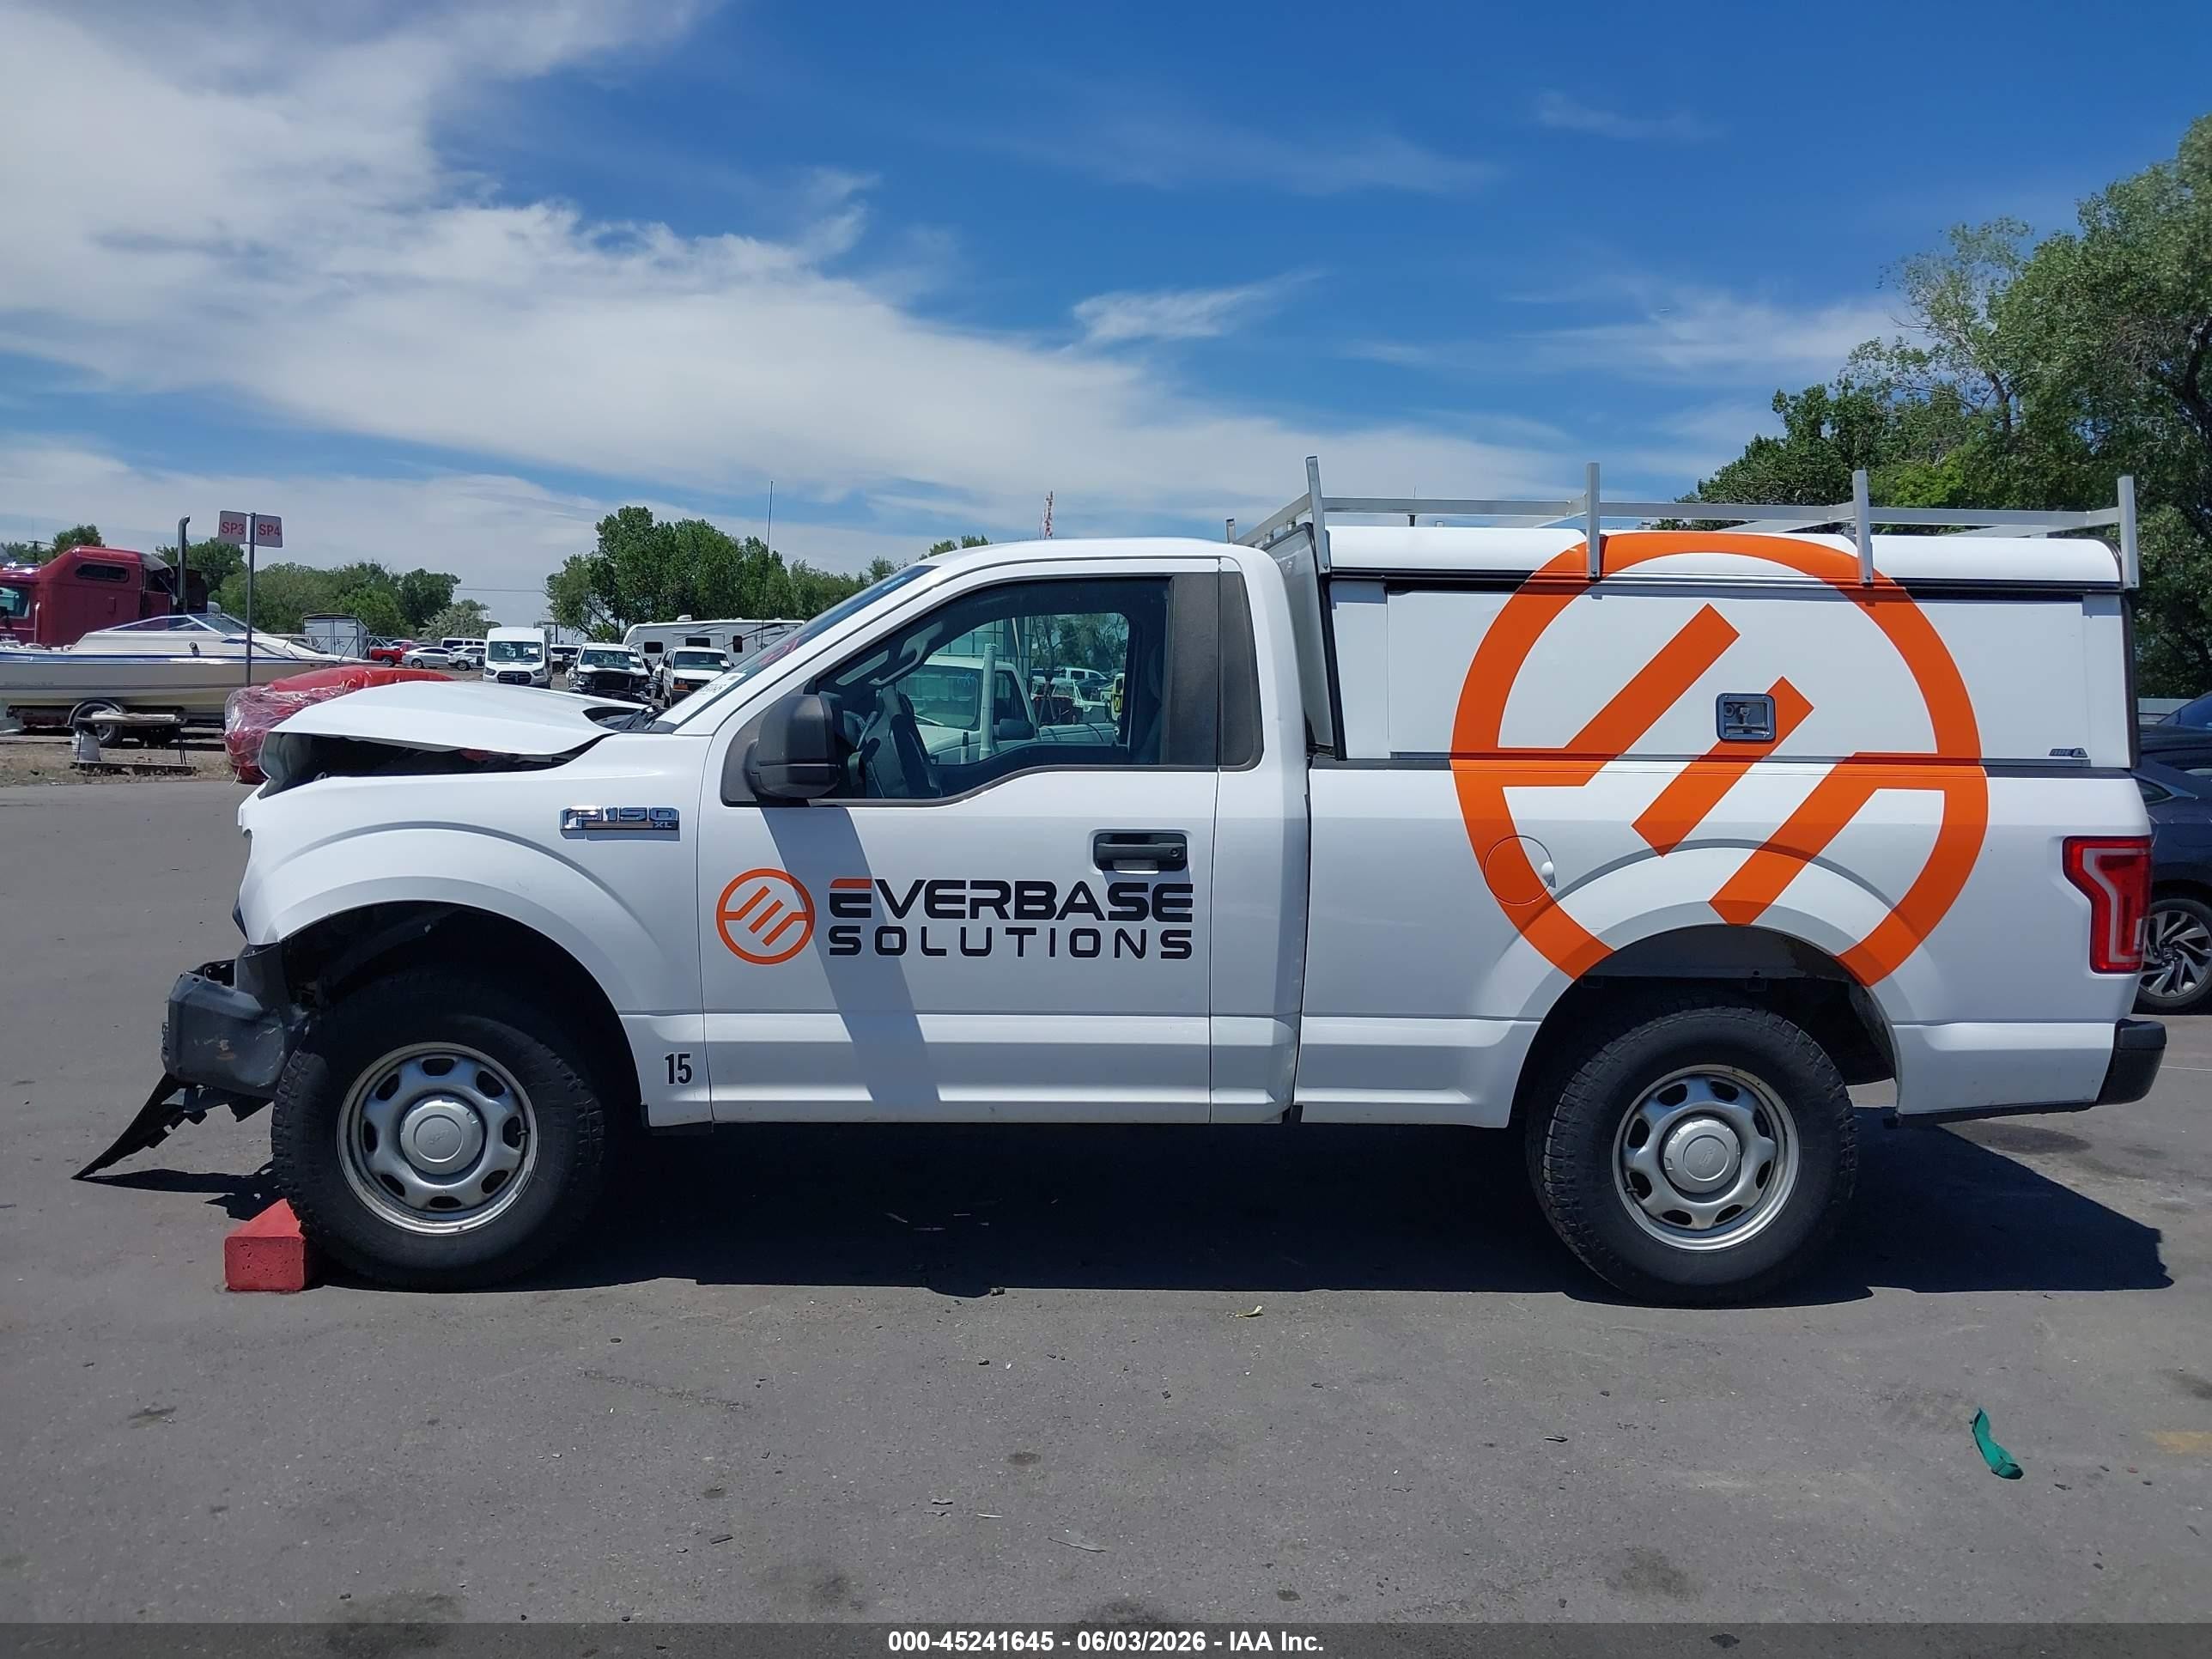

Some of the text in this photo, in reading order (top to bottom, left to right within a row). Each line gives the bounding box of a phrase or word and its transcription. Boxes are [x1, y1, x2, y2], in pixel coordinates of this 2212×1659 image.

[221, 521, 245, 536] SP3
[258, 523, 281, 537] SP4
[829, 878, 1194, 923] EVERBASE
[828, 925, 1194, 960] SOLUTIONS
[665, 1053, 692, 1085] 15
